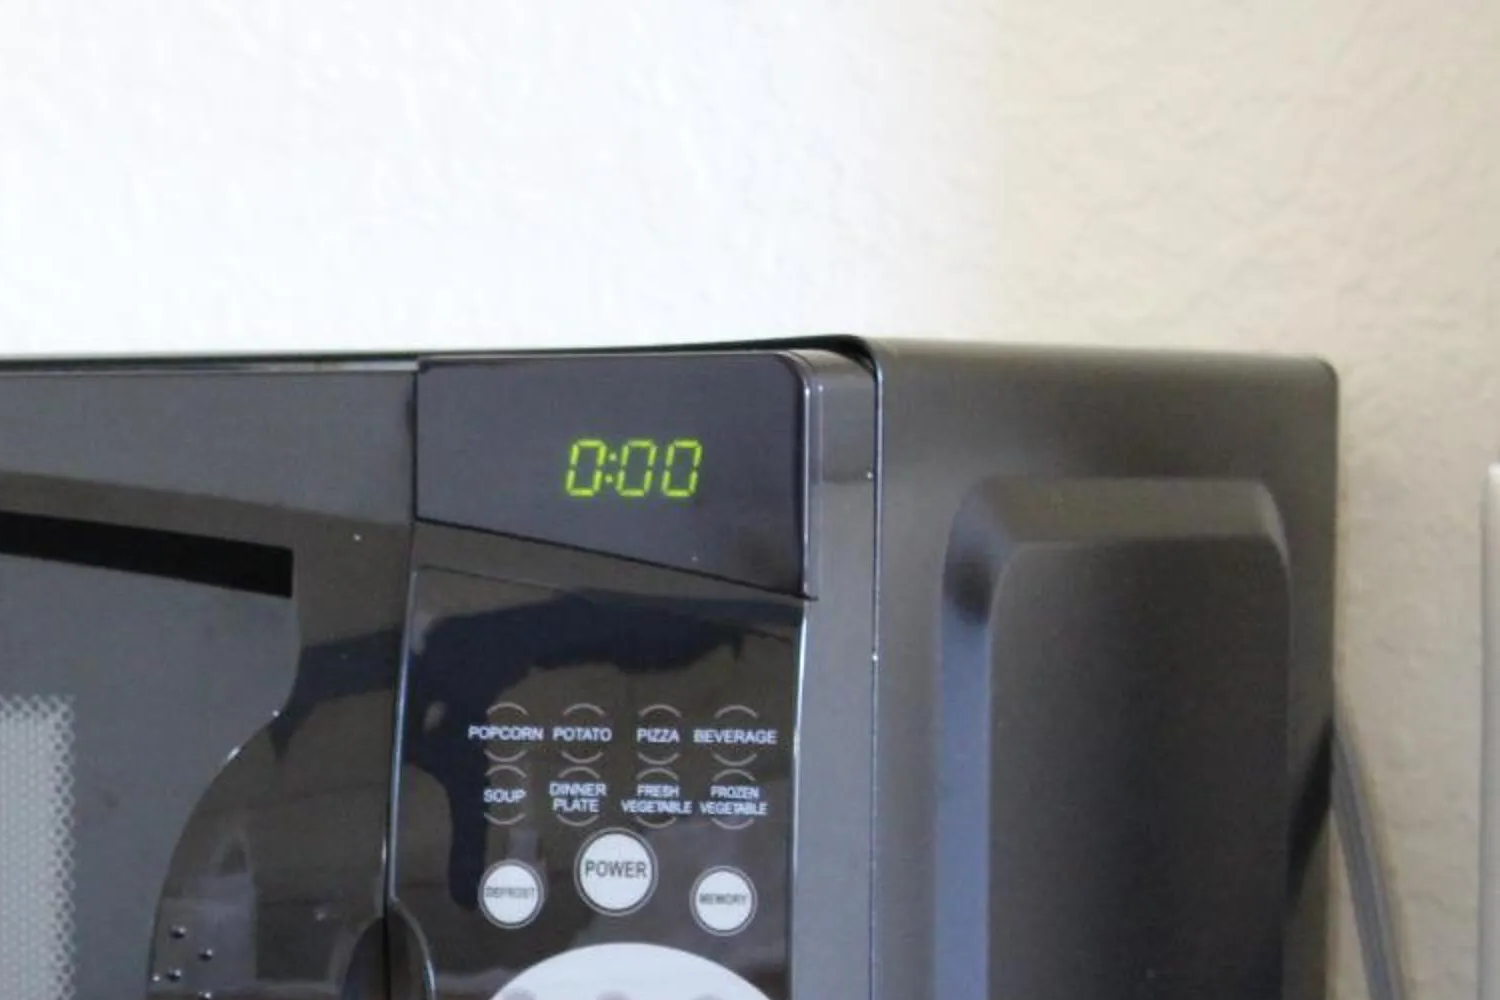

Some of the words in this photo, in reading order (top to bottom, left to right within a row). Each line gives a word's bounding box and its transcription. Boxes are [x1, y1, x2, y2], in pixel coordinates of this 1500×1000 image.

[565, 438, 703, 498] 0:00
[468, 725, 544, 742] POPCORN
[552, 726, 613, 742] POTATO
[636, 728, 681, 744] PIZZA
[693, 728, 778, 745] BEVERAGE
[483, 788, 527, 803] SOUP
[549, 781, 607, 797] DINNER
[710, 785, 760, 799] FROZEN
[552, 797, 599, 813] PLATE
[620, 799, 692, 815] VEGETABLE
[699, 801, 768, 816] VEGETABLE
[584, 860, 648, 879] POWER
[699, 892, 748, 906] MEMORY
